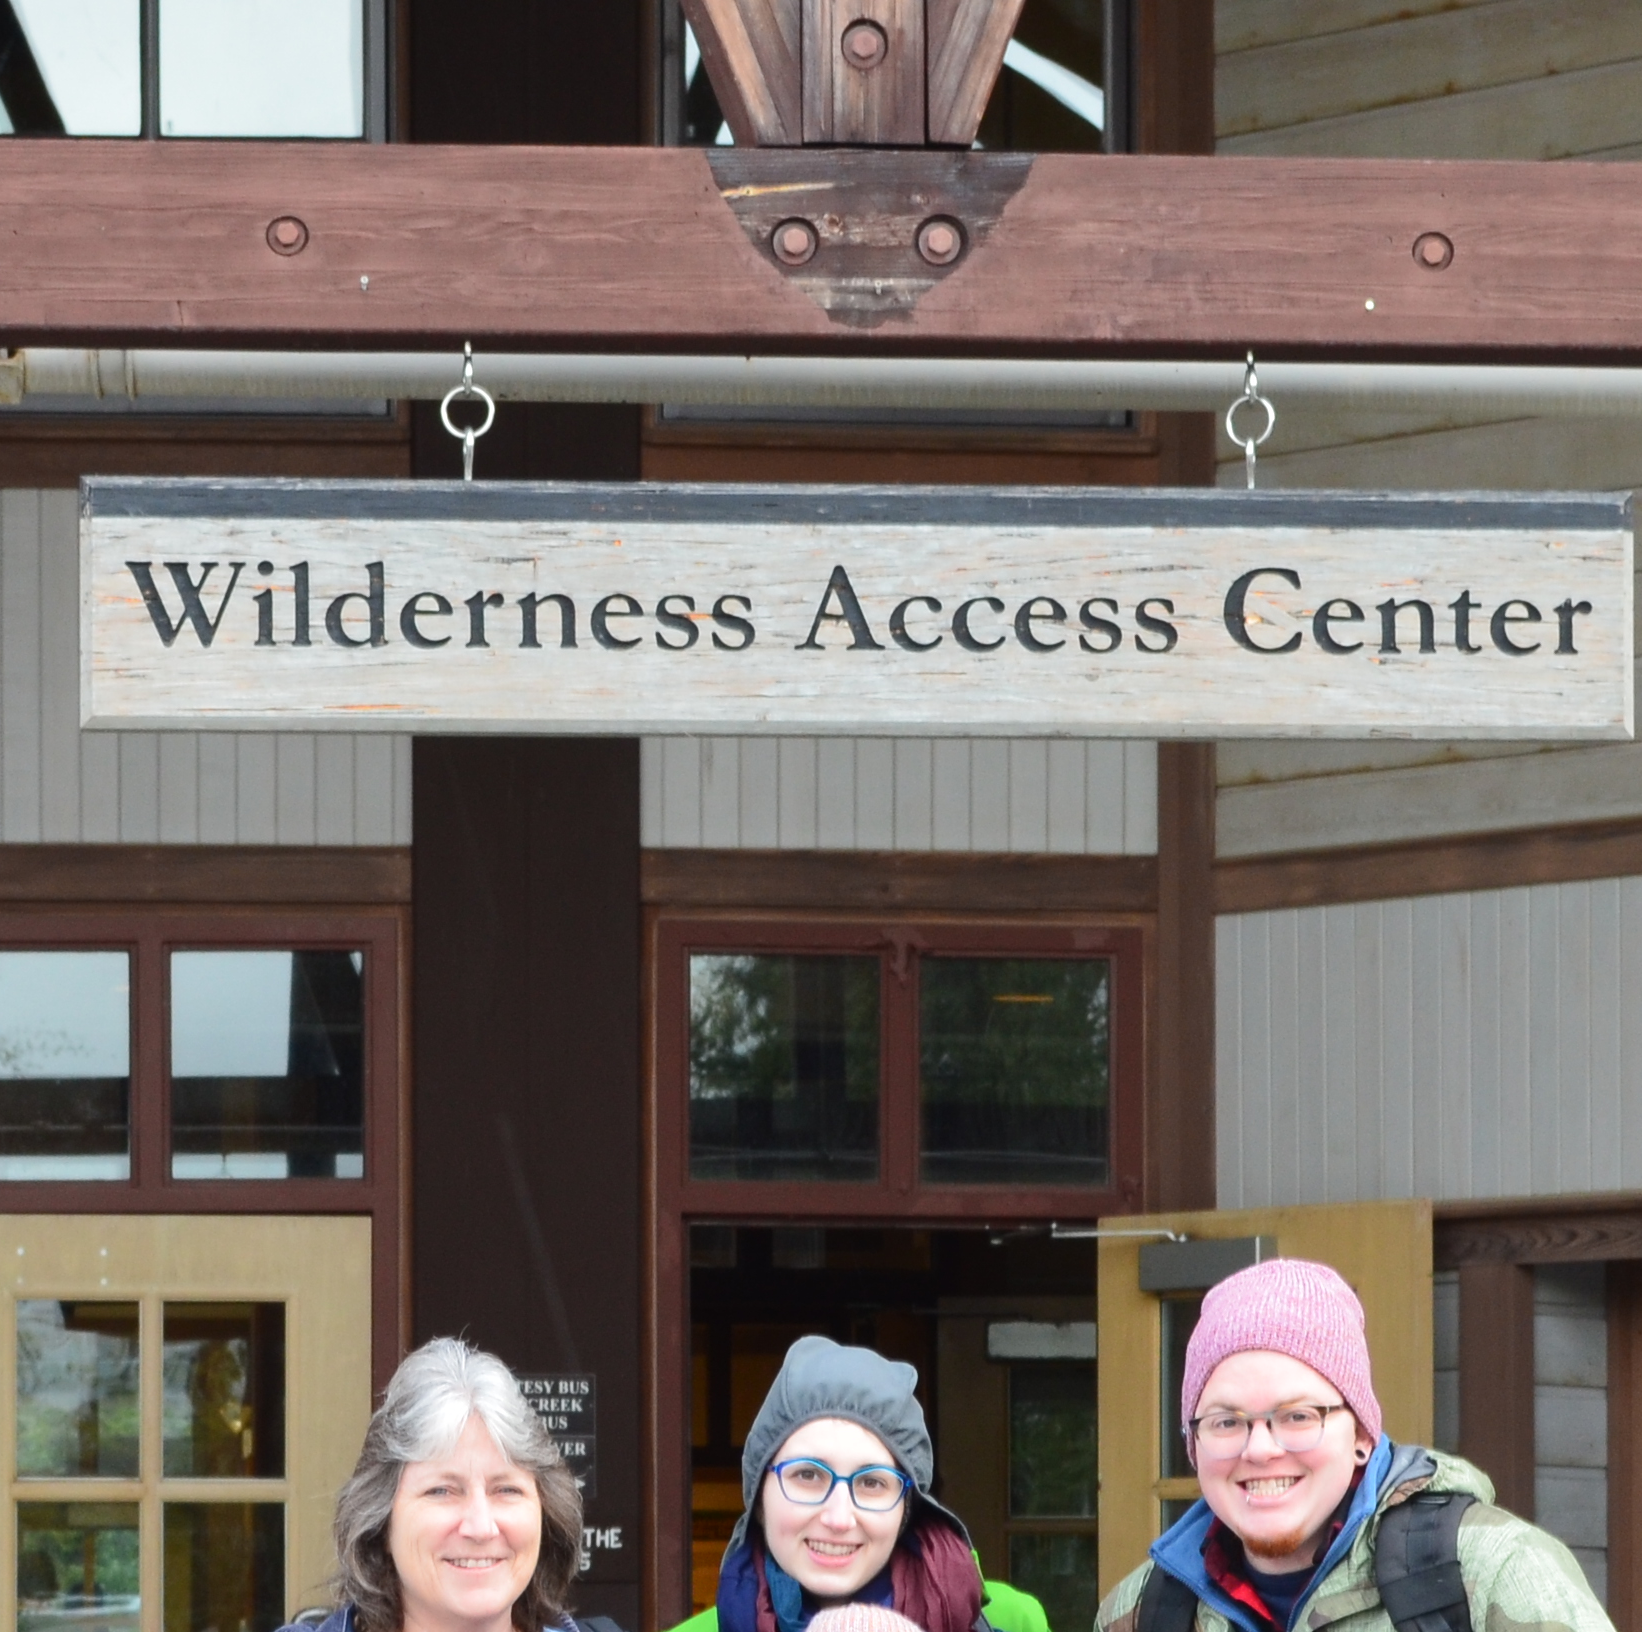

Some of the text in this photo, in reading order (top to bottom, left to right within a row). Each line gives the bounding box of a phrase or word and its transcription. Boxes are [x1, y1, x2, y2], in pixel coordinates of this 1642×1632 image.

[124, 560, 1593, 657] Wilderness Access Center
[558, 1380, 590, 1395] BUS
[583, 1527, 623, 1549] THE
